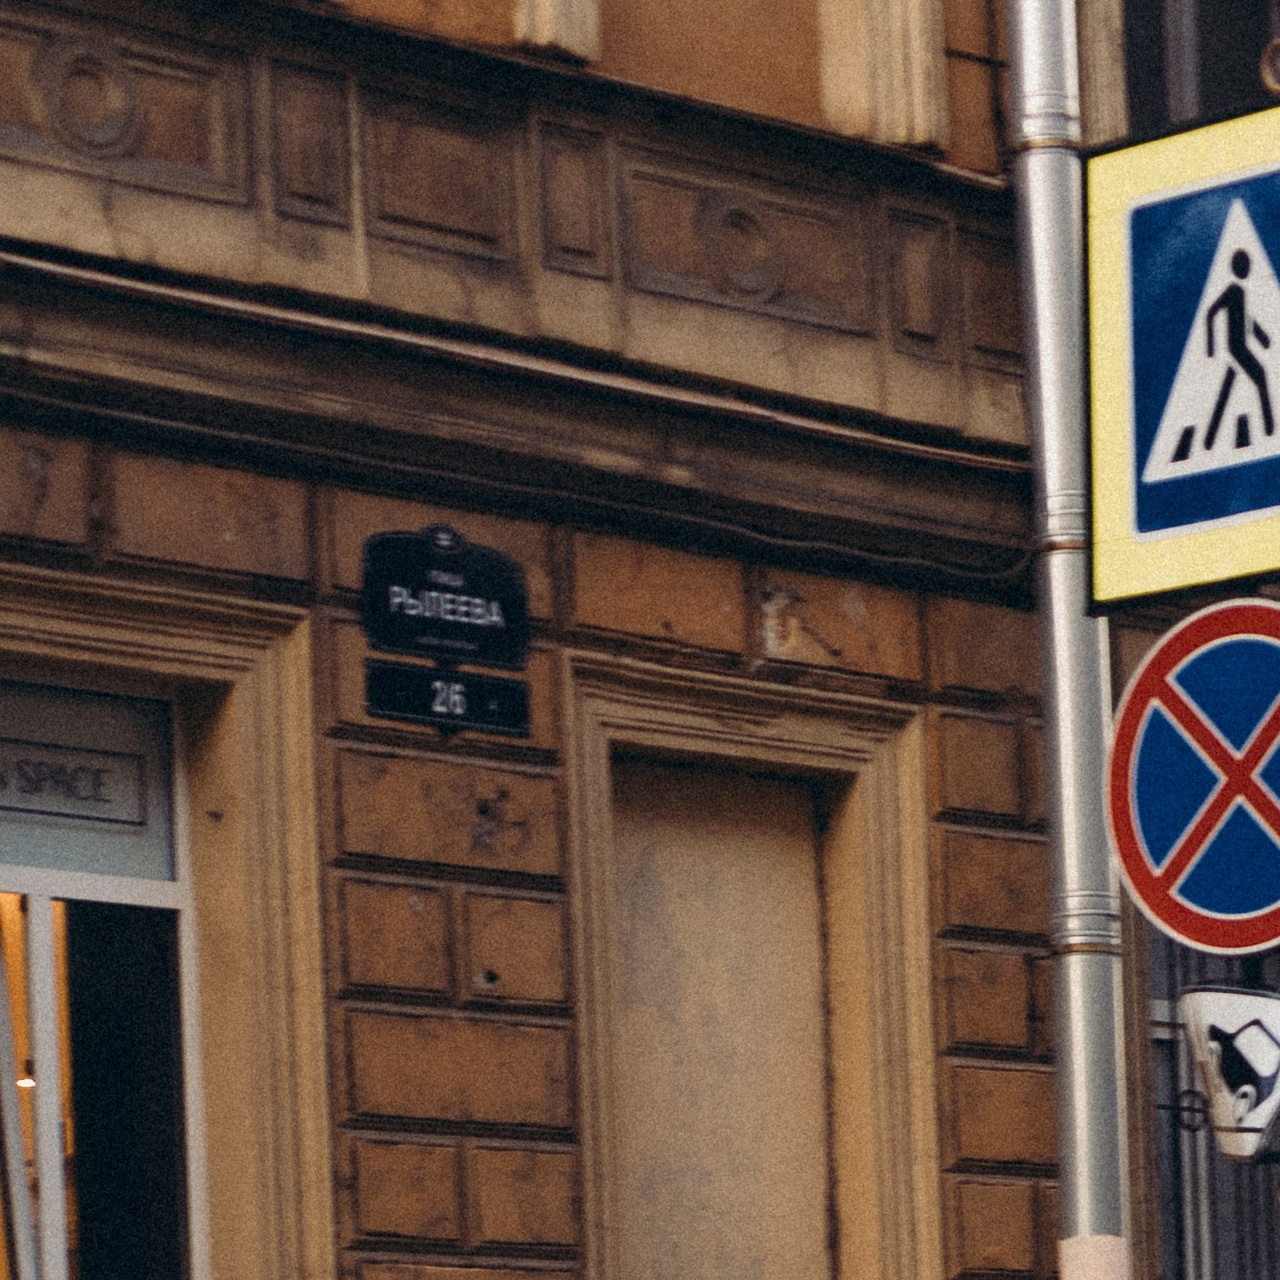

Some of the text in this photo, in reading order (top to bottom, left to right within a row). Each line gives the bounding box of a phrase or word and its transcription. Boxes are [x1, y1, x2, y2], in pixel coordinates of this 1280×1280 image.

[390, 584, 505, 626] РЫЛЕЕВА
[431, 680, 466, 715] 26
[16, 758, 112, 803] SPACE
